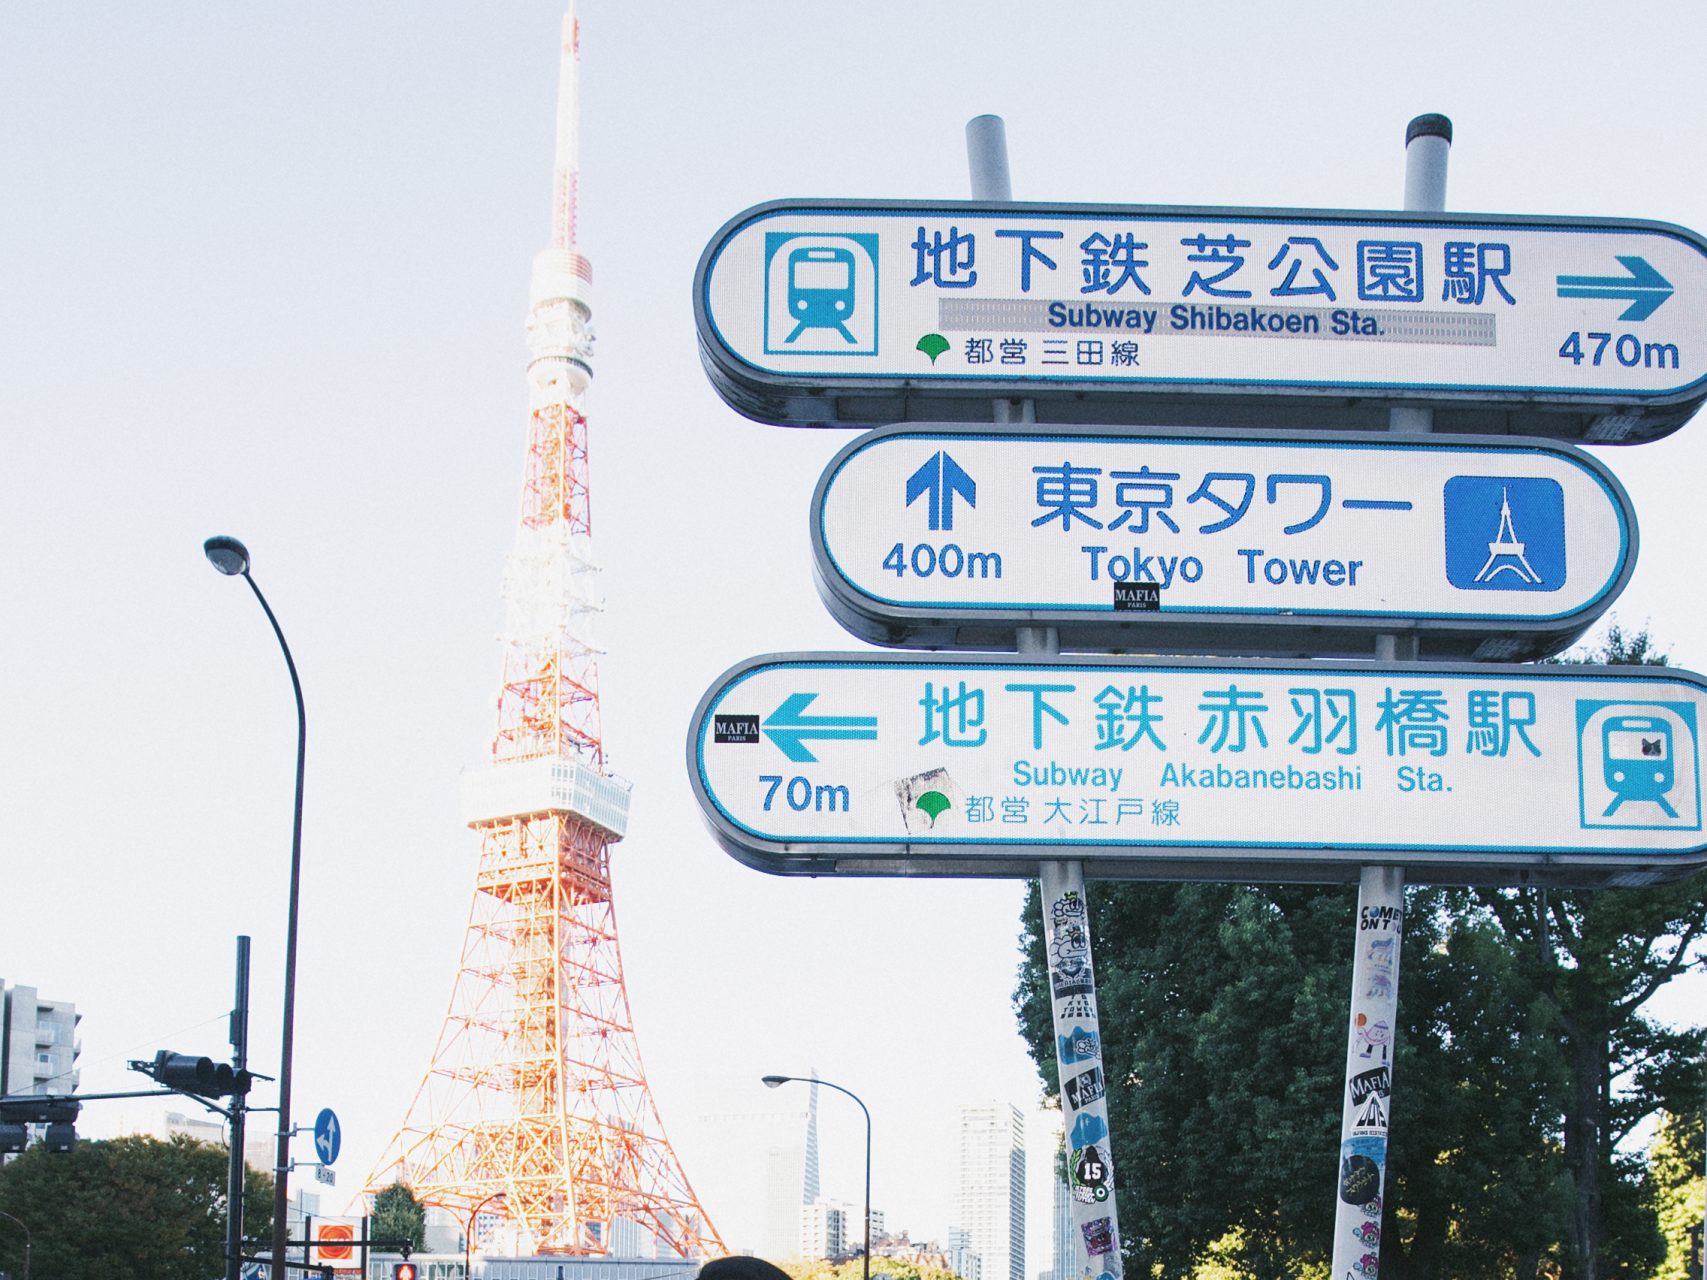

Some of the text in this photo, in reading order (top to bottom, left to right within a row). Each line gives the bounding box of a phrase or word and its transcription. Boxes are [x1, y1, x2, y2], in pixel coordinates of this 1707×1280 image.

[1047, 302, 1386, 337] Subway Shibakoen Sta.
[1557, 331, 1681, 369] 470m
[1030, 461, 1413, 535] 東京タワー
[882, 542, 1003, 579] 400m
[1081, 545, 1364, 590] Tokyo Tower
[1114, 588, 1160, 602] MAFIA
[714, 721, 760, 736] MAFIA
[1013, 759, 1454, 793] Subway Akabanebashi Sta.
[758, 775, 850, 812] 70m
[1360, 918, 1380, 931] ON
[1350, 1071, 1390, 1099] MAFIA
[1083, 1162, 1102, 1180] 15
